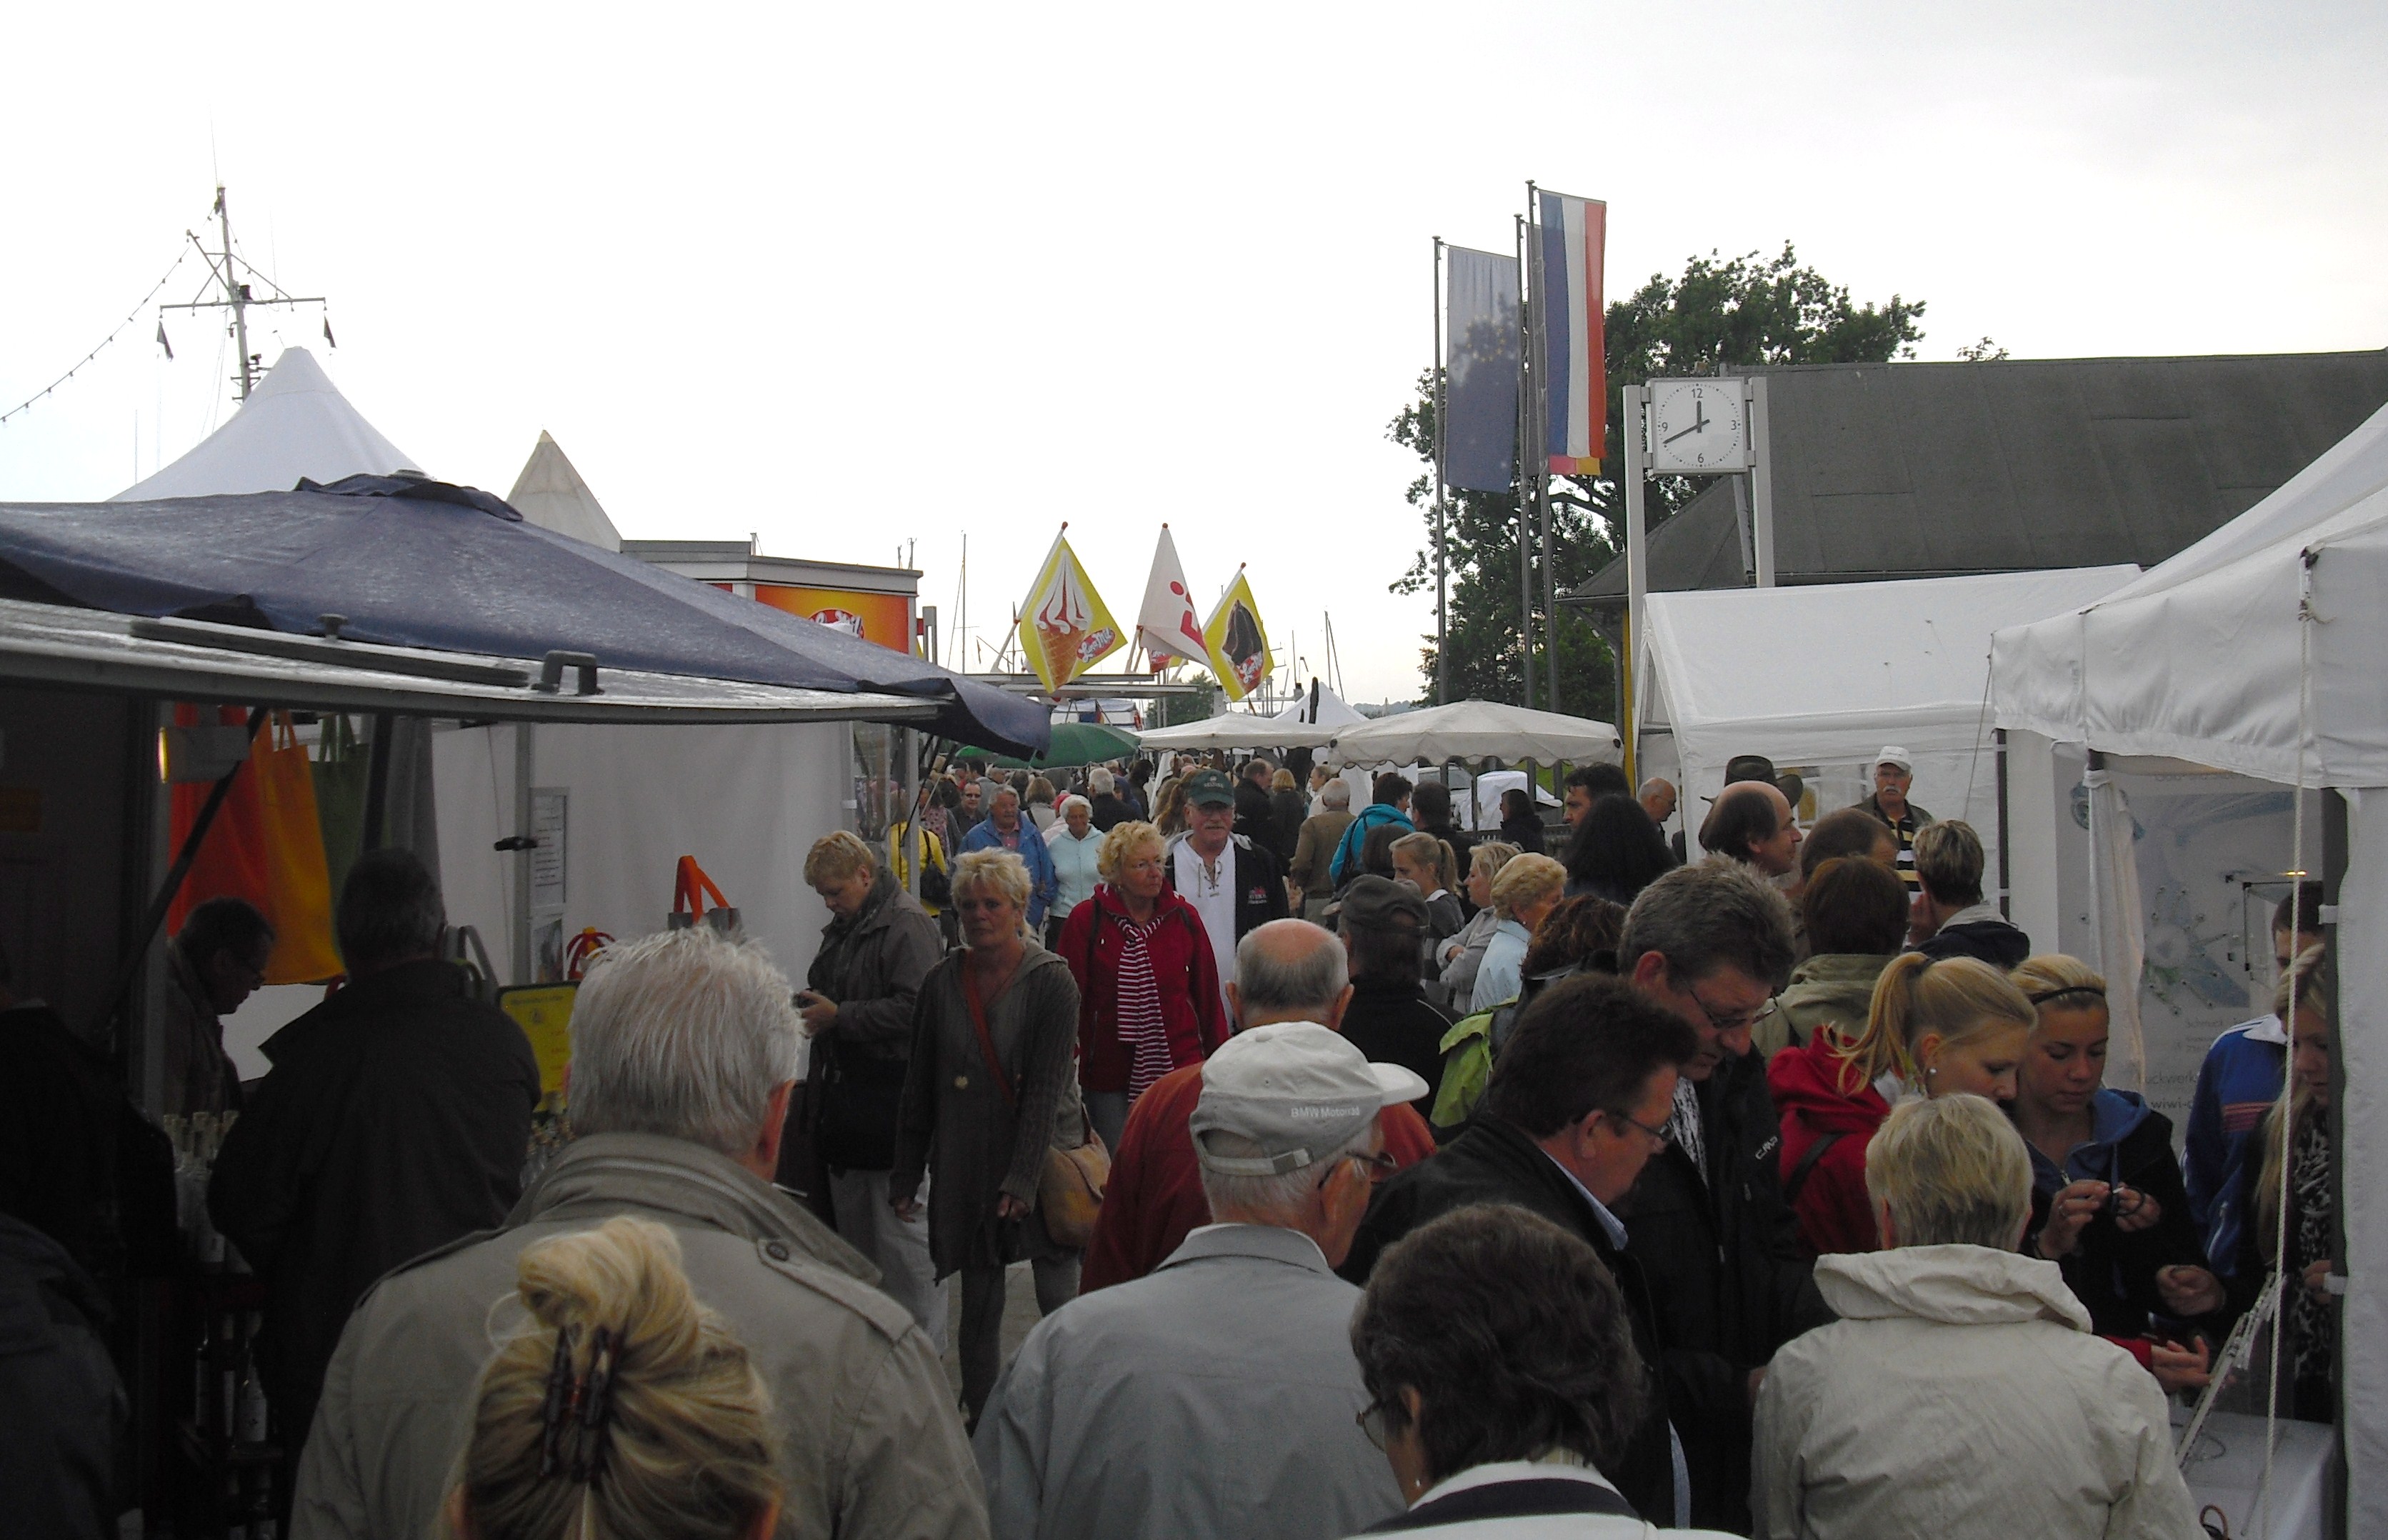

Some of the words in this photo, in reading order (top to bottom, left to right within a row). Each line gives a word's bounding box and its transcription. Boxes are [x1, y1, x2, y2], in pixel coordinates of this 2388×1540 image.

[1691, 388, 1704, 399] 12
[1662, 421, 1669, 432] 9
[1731, 419, 1737, 431] 3
[1697, 452, 1704, 464] 6
[1290, 1107, 1319, 1119] BMW
[1320, 1106, 1360, 1117] Motorrad
